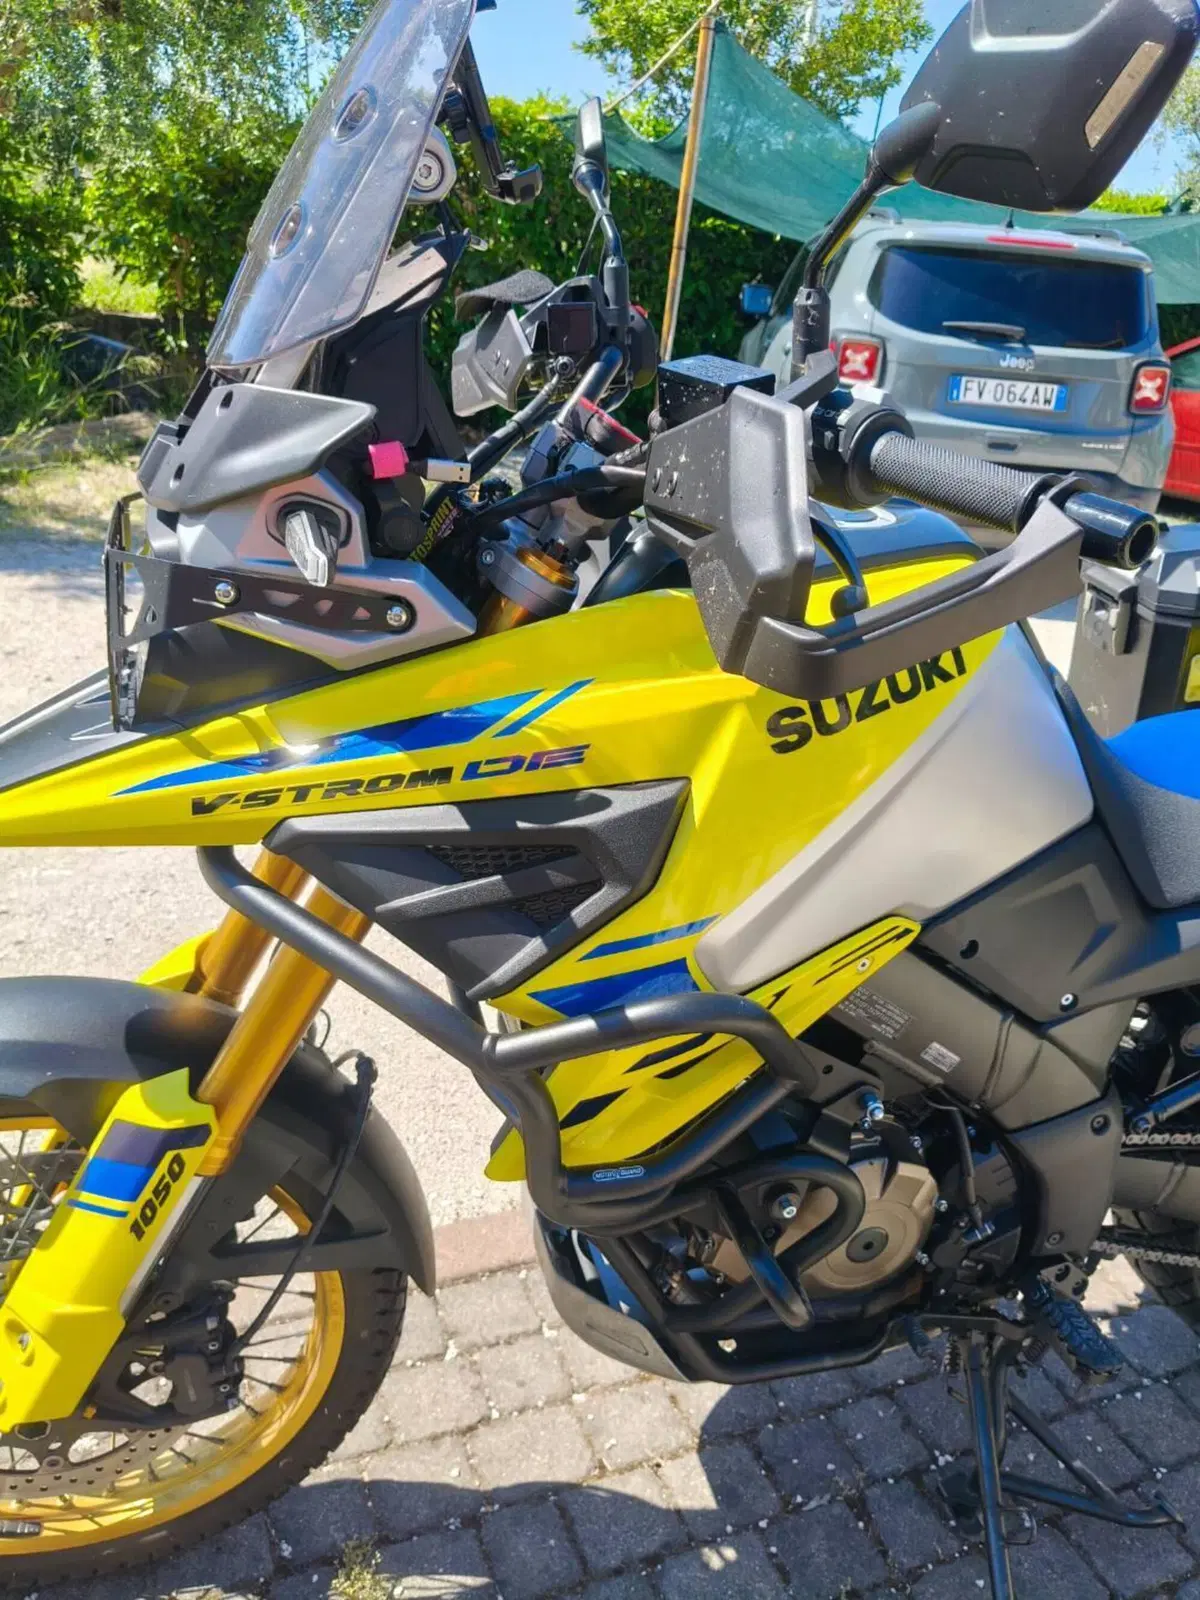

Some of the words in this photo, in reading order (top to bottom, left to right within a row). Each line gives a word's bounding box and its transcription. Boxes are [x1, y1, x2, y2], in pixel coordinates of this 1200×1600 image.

[963, 379, 988, 400] FV
[993, 382, 1055, 407] 064AW
[1000, 354, 1035, 371] Jeep
[405, 496, 454, 564] TOSPRINT
[766, 646, 967, 755] SUZUKI
[191, 766, 454, 816] V-STROM
[460, 743, 592, 782] DE
[130, 1152, 186, 1242] 1050
